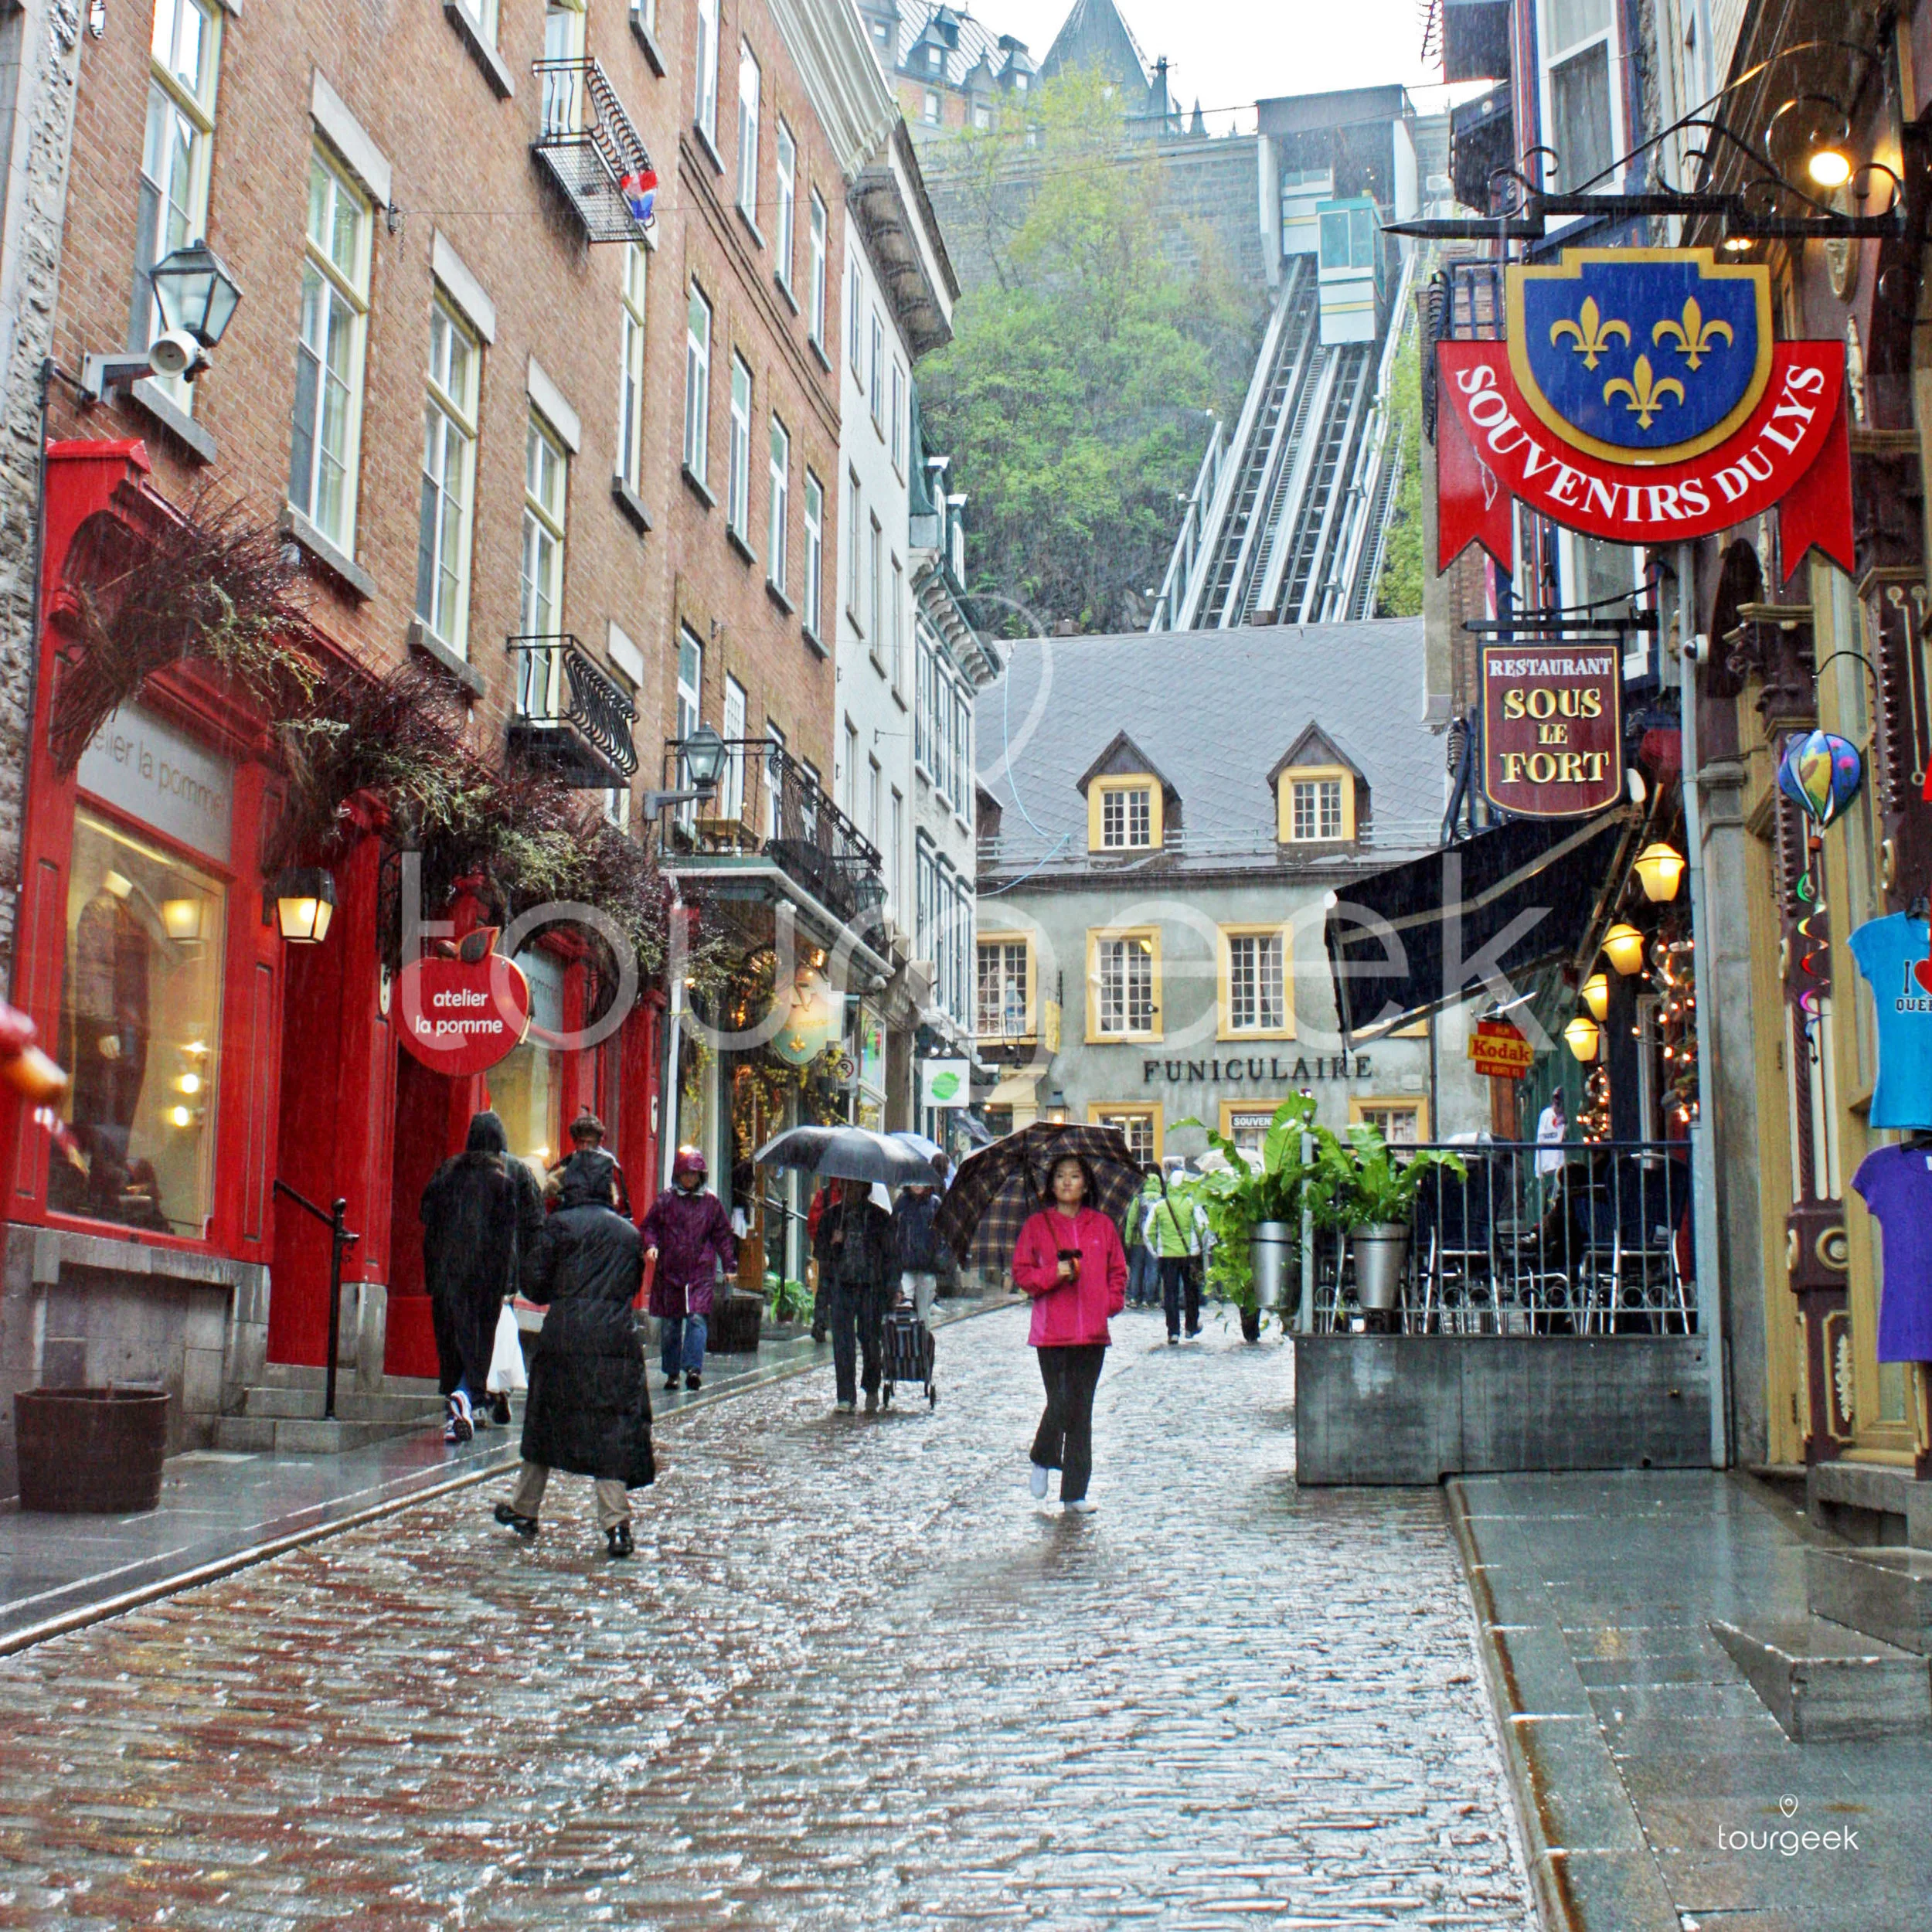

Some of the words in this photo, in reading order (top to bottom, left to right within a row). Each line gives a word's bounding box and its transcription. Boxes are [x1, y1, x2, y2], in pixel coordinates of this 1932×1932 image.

[1456, 365, 1711, 522] SOUVENIRS
[1710, 444, 1774, 503] DU
[1759, 365, 1825, 455] LYS
[1488, 658, 1612, 677] RESTAURANT
[1503, 687, 1603, 720] SOUS
[1537, 723, 1568, 744] LE
[1499, 751, 1610, 783] FORT
[433, 988, 488, 1007] atelier
[415, 1015, 432, 1034] la
[436, 1019, 503, 1037] pomme
[1471, 1039, 1530, 1062] Kodak
[1144, 1056, 1372, 1083] FUNICULAIRE
[1233, 1117, 1272, 1127] SOUVEN
